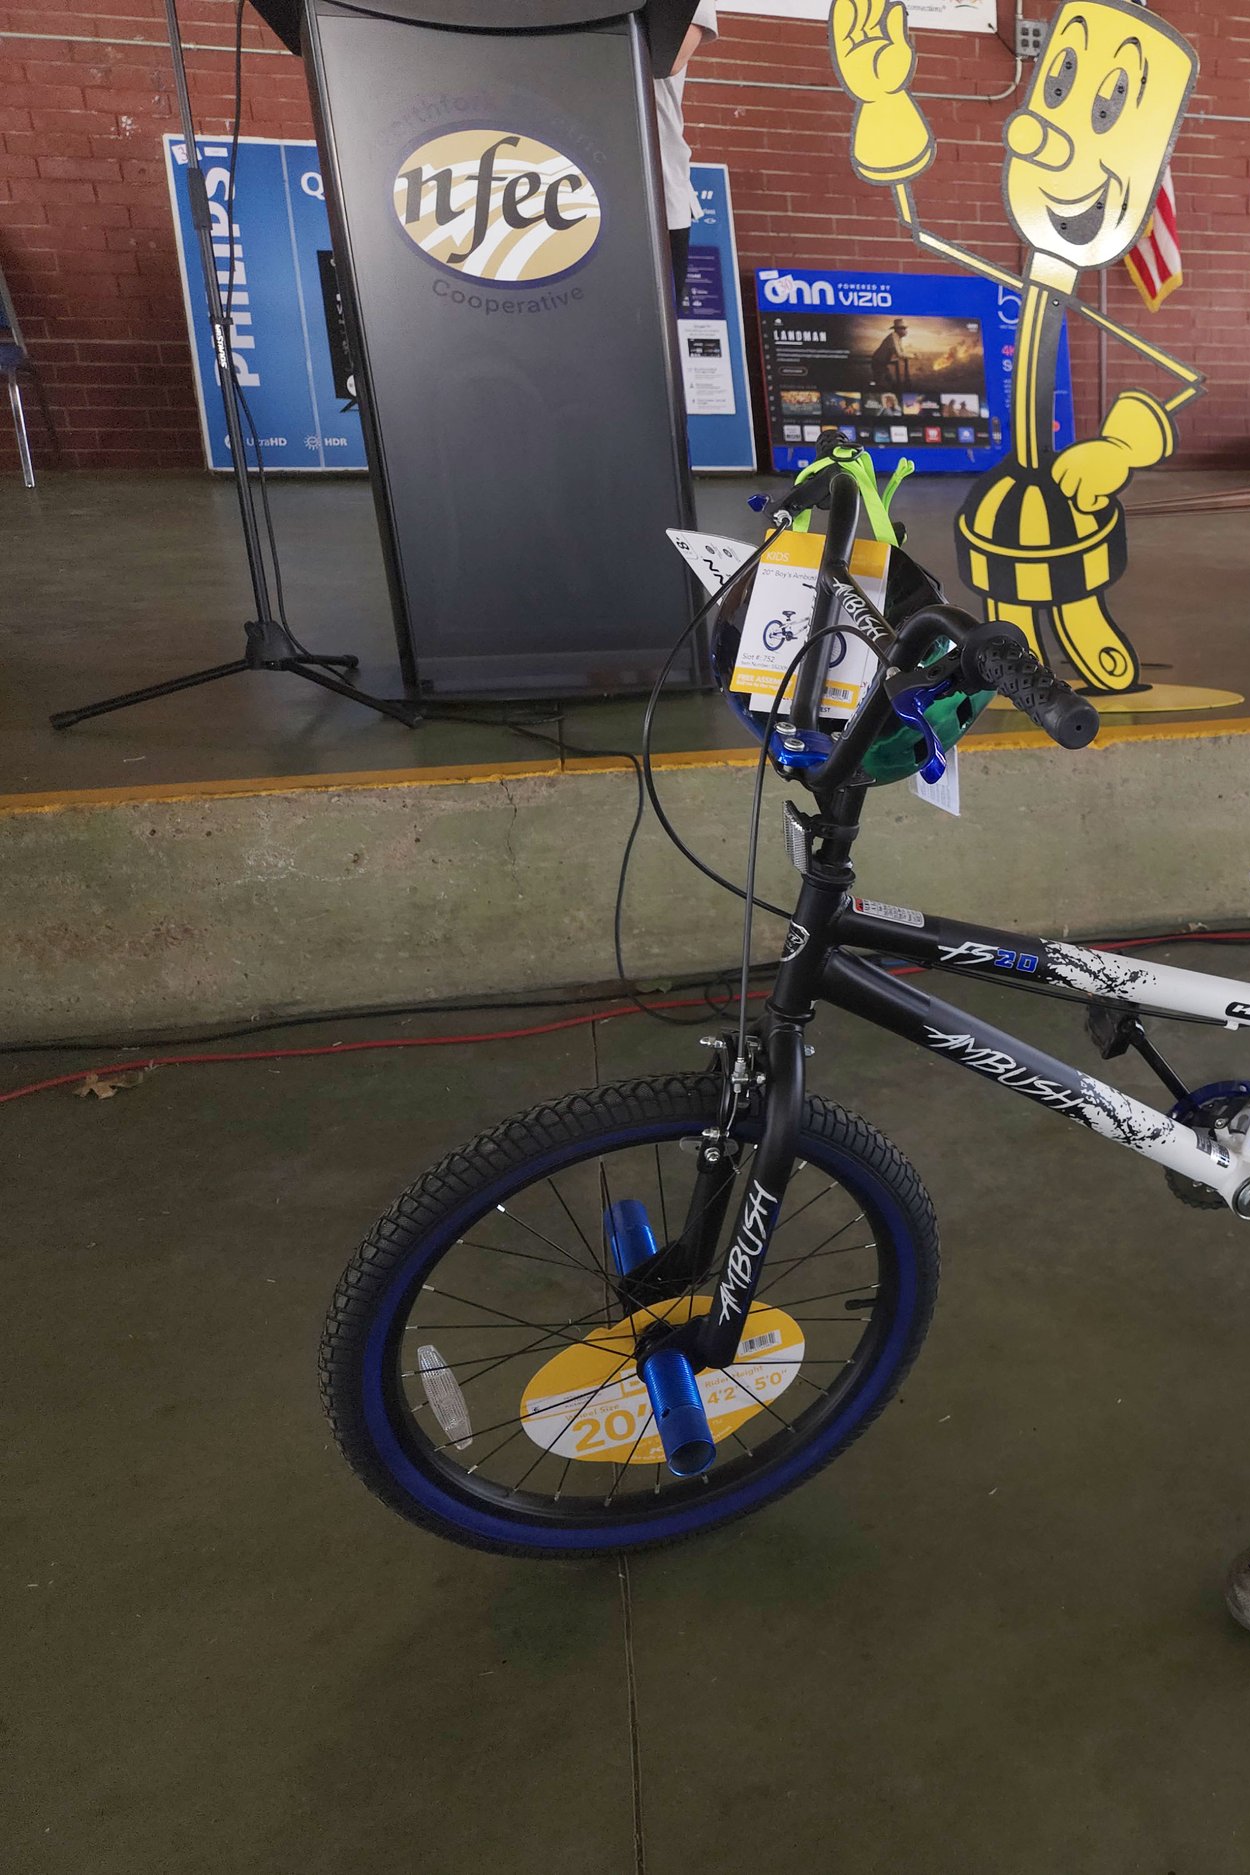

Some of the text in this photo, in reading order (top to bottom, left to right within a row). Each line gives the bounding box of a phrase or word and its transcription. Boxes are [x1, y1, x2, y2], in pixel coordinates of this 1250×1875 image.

[398, 136, 587, 264] nfec
[432, 279, 584, 315] Cooperative
[838, 291, 892, 307] VIZIO
[773, 330, 827, 342] LANDMAN
[324, 437, 348, 447] HDR
[766, 551, 790, 561] KIDS
[833, 576, 889, 641] AMBUSH
[938, 941, 1039, 974] FS20
[923, 1024, 1085, 1110] AMBUSH
[718, 1179, 778, 1326] AMBUSH
